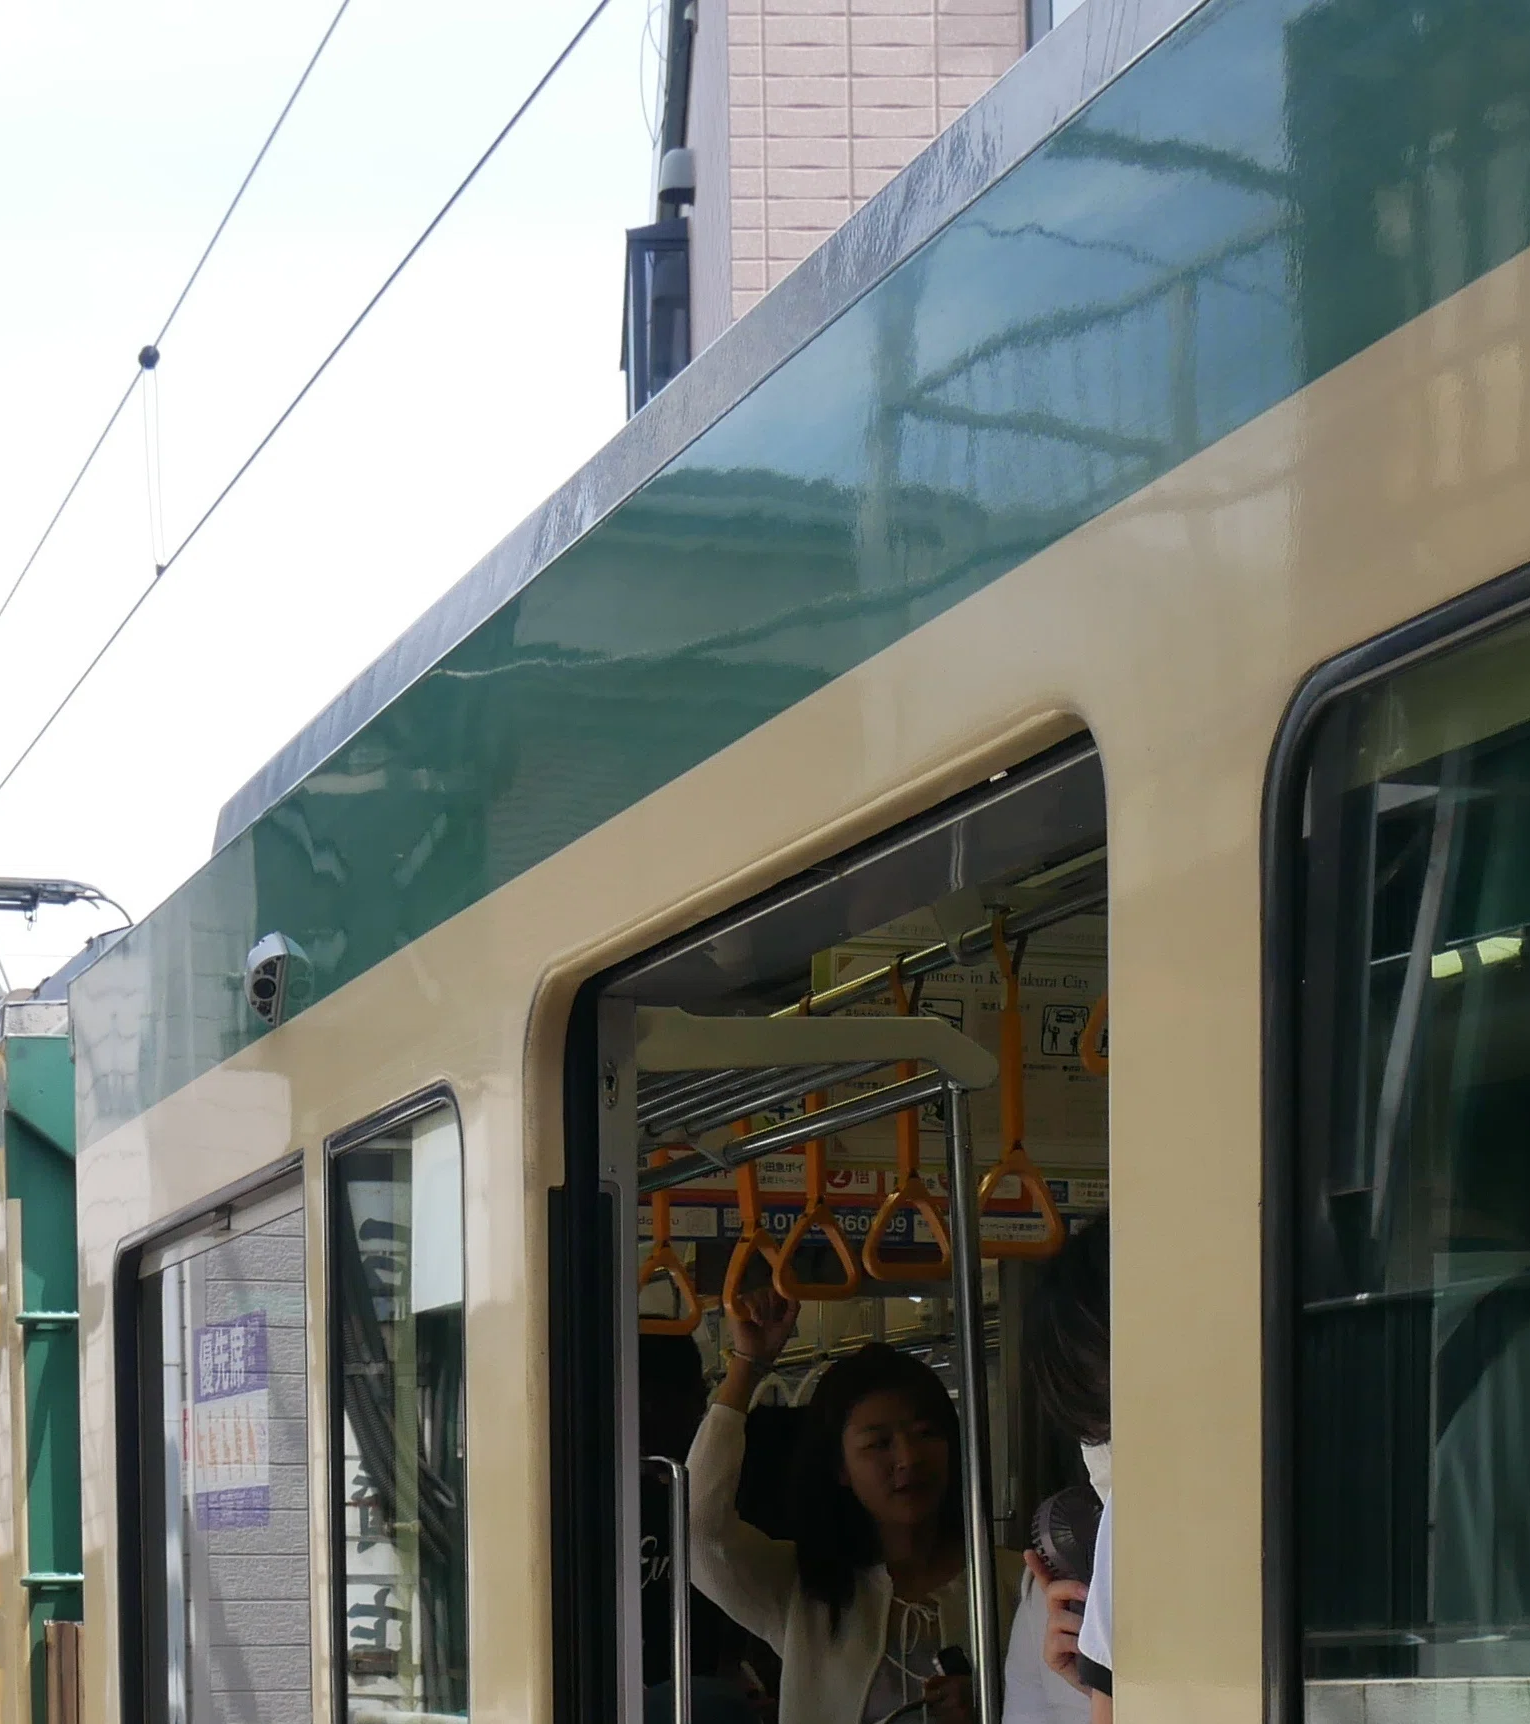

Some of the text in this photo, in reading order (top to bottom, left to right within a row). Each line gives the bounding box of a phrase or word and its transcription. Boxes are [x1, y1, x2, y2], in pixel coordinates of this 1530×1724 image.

[1063, 974, 1089, 993] City
[200, 1322, 245, 1397] 優先席
